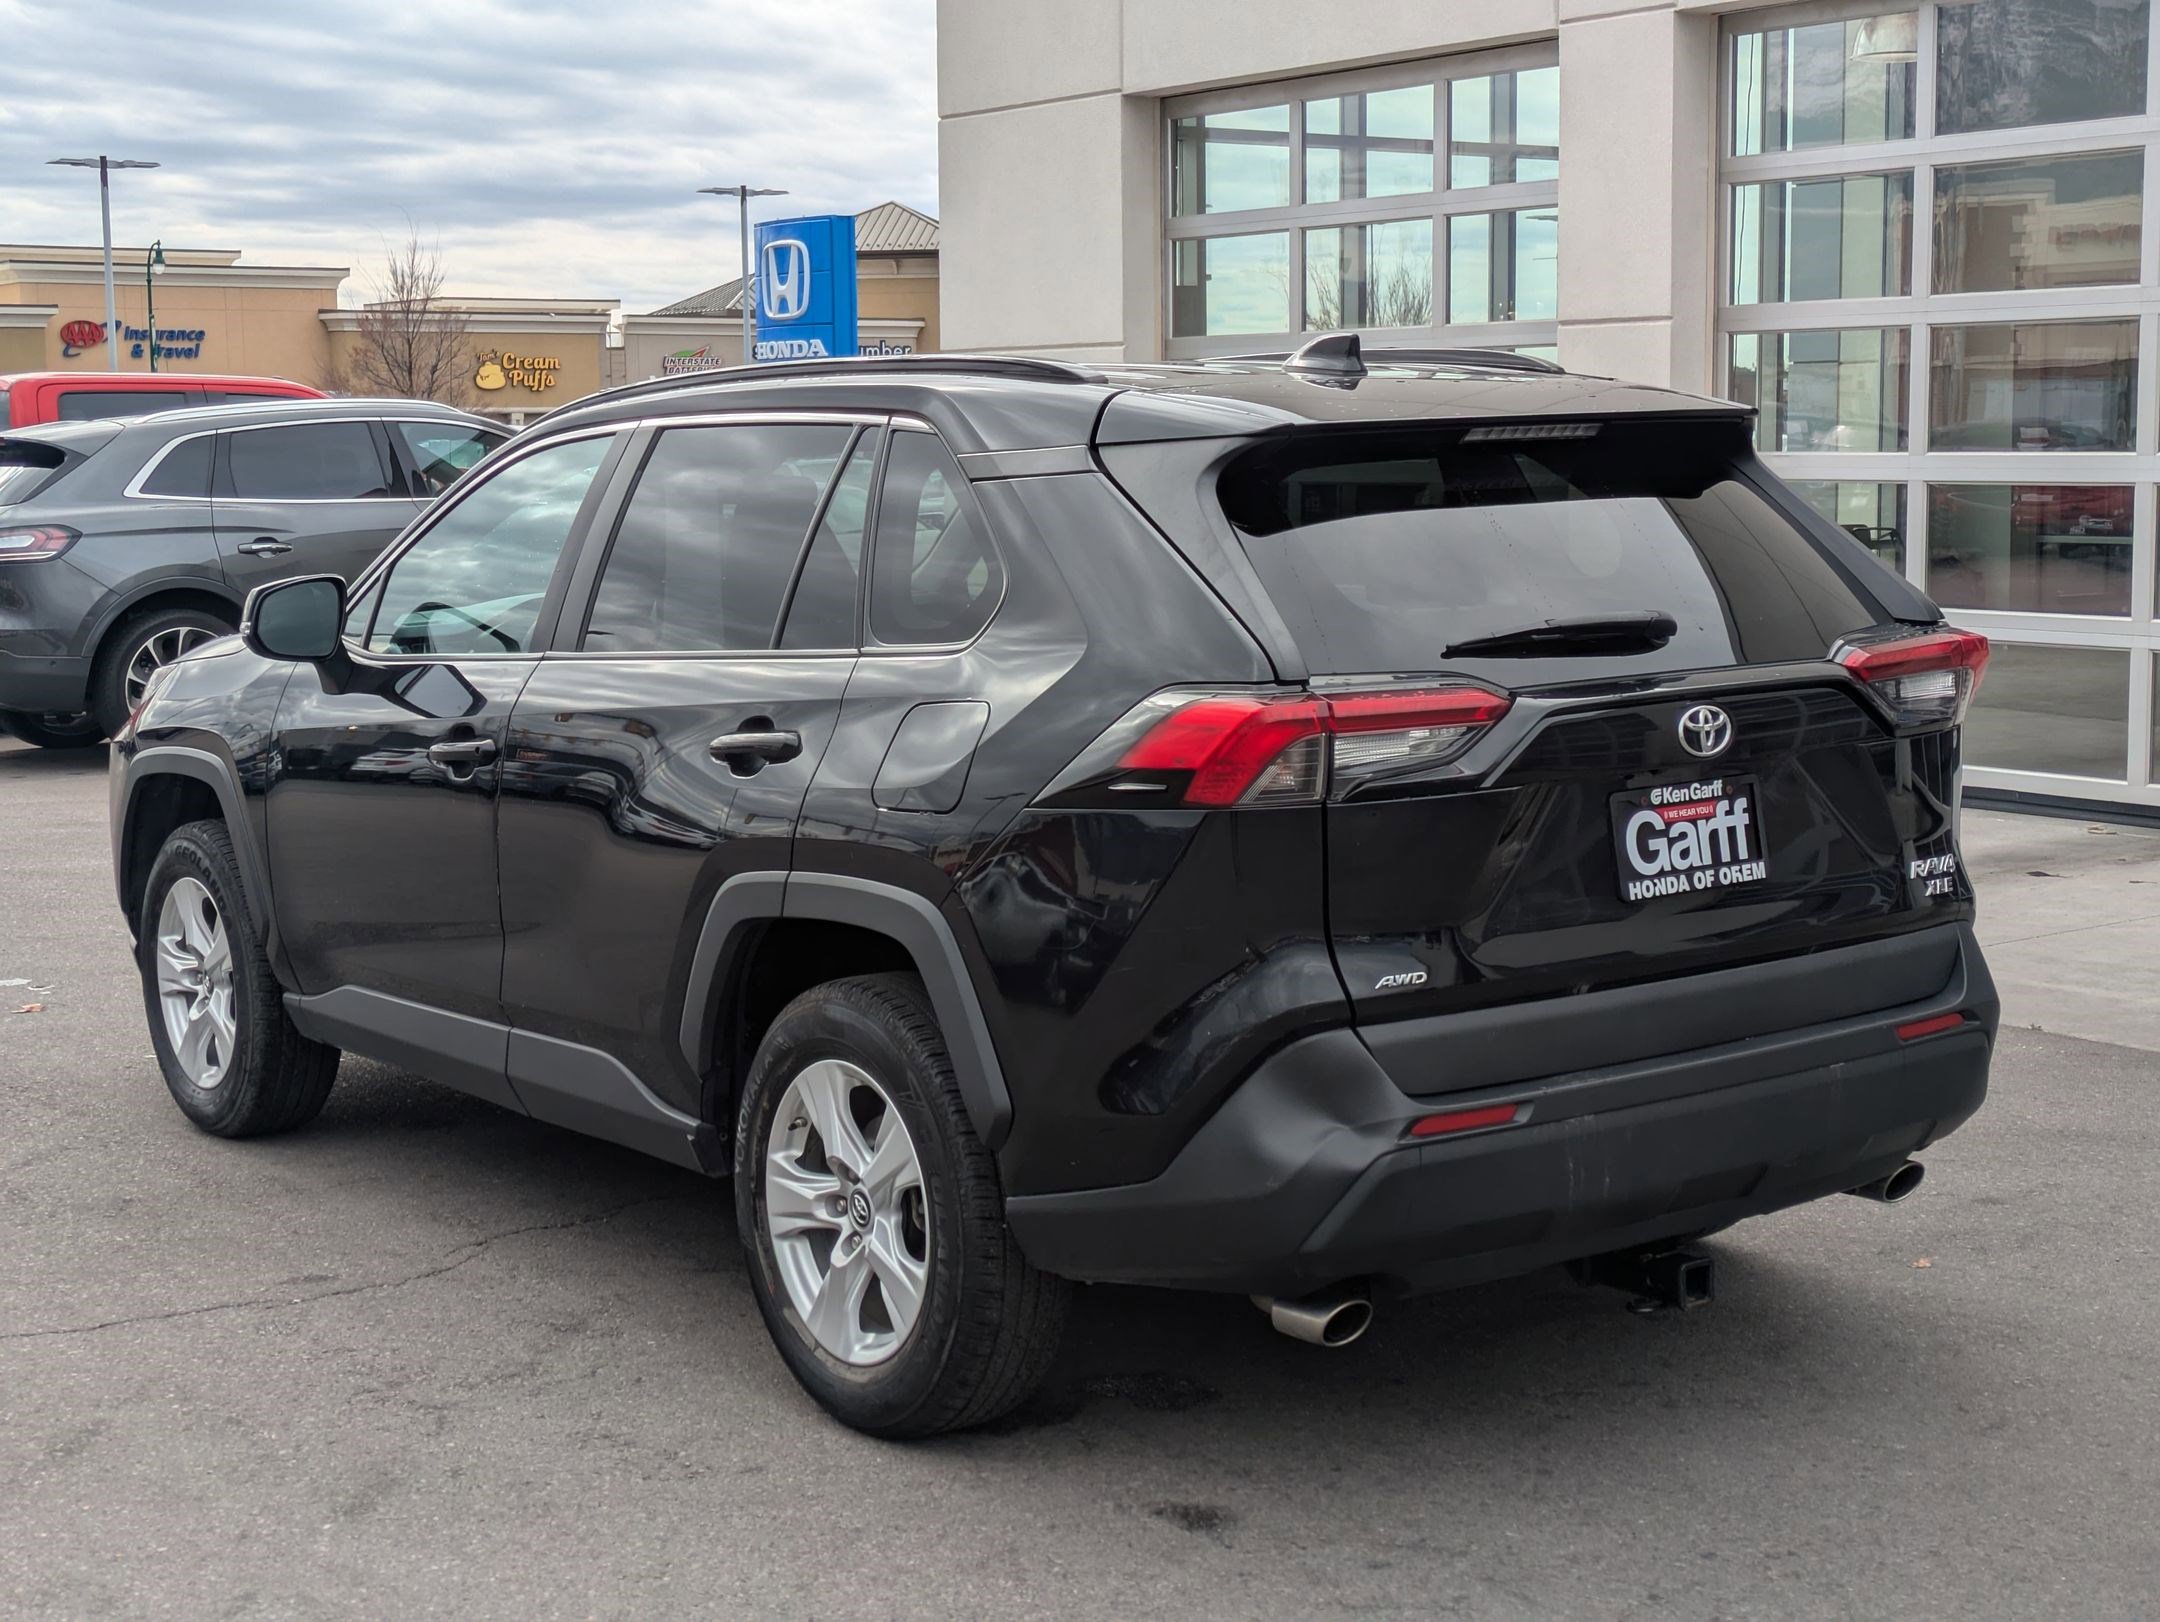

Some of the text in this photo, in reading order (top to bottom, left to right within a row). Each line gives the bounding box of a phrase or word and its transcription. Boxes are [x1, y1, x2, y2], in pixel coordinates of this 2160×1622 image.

[64, 321, 102, 346] AAA
[131, 343, 143, 358] &
[754, 339, 828, 360] HONDA
[502, 352, 560, 369] Cream
[666, 357, 721, 366] INTERSTATE
[509, 370, 555, 391] Puffs
[668, 367, 714, 375] BATTER
[1663, 779, 1723, 804] Ken Garff
[1669, 804, 1709, 818] WE HEAR YOU
[1626, 797, 1750, 876] Garff
[1629, 861, 1767, 901] HONDA OF OREM
[1925, 876, 1954, 896] XLE
[1374, 971, 1428, 990] AWD
